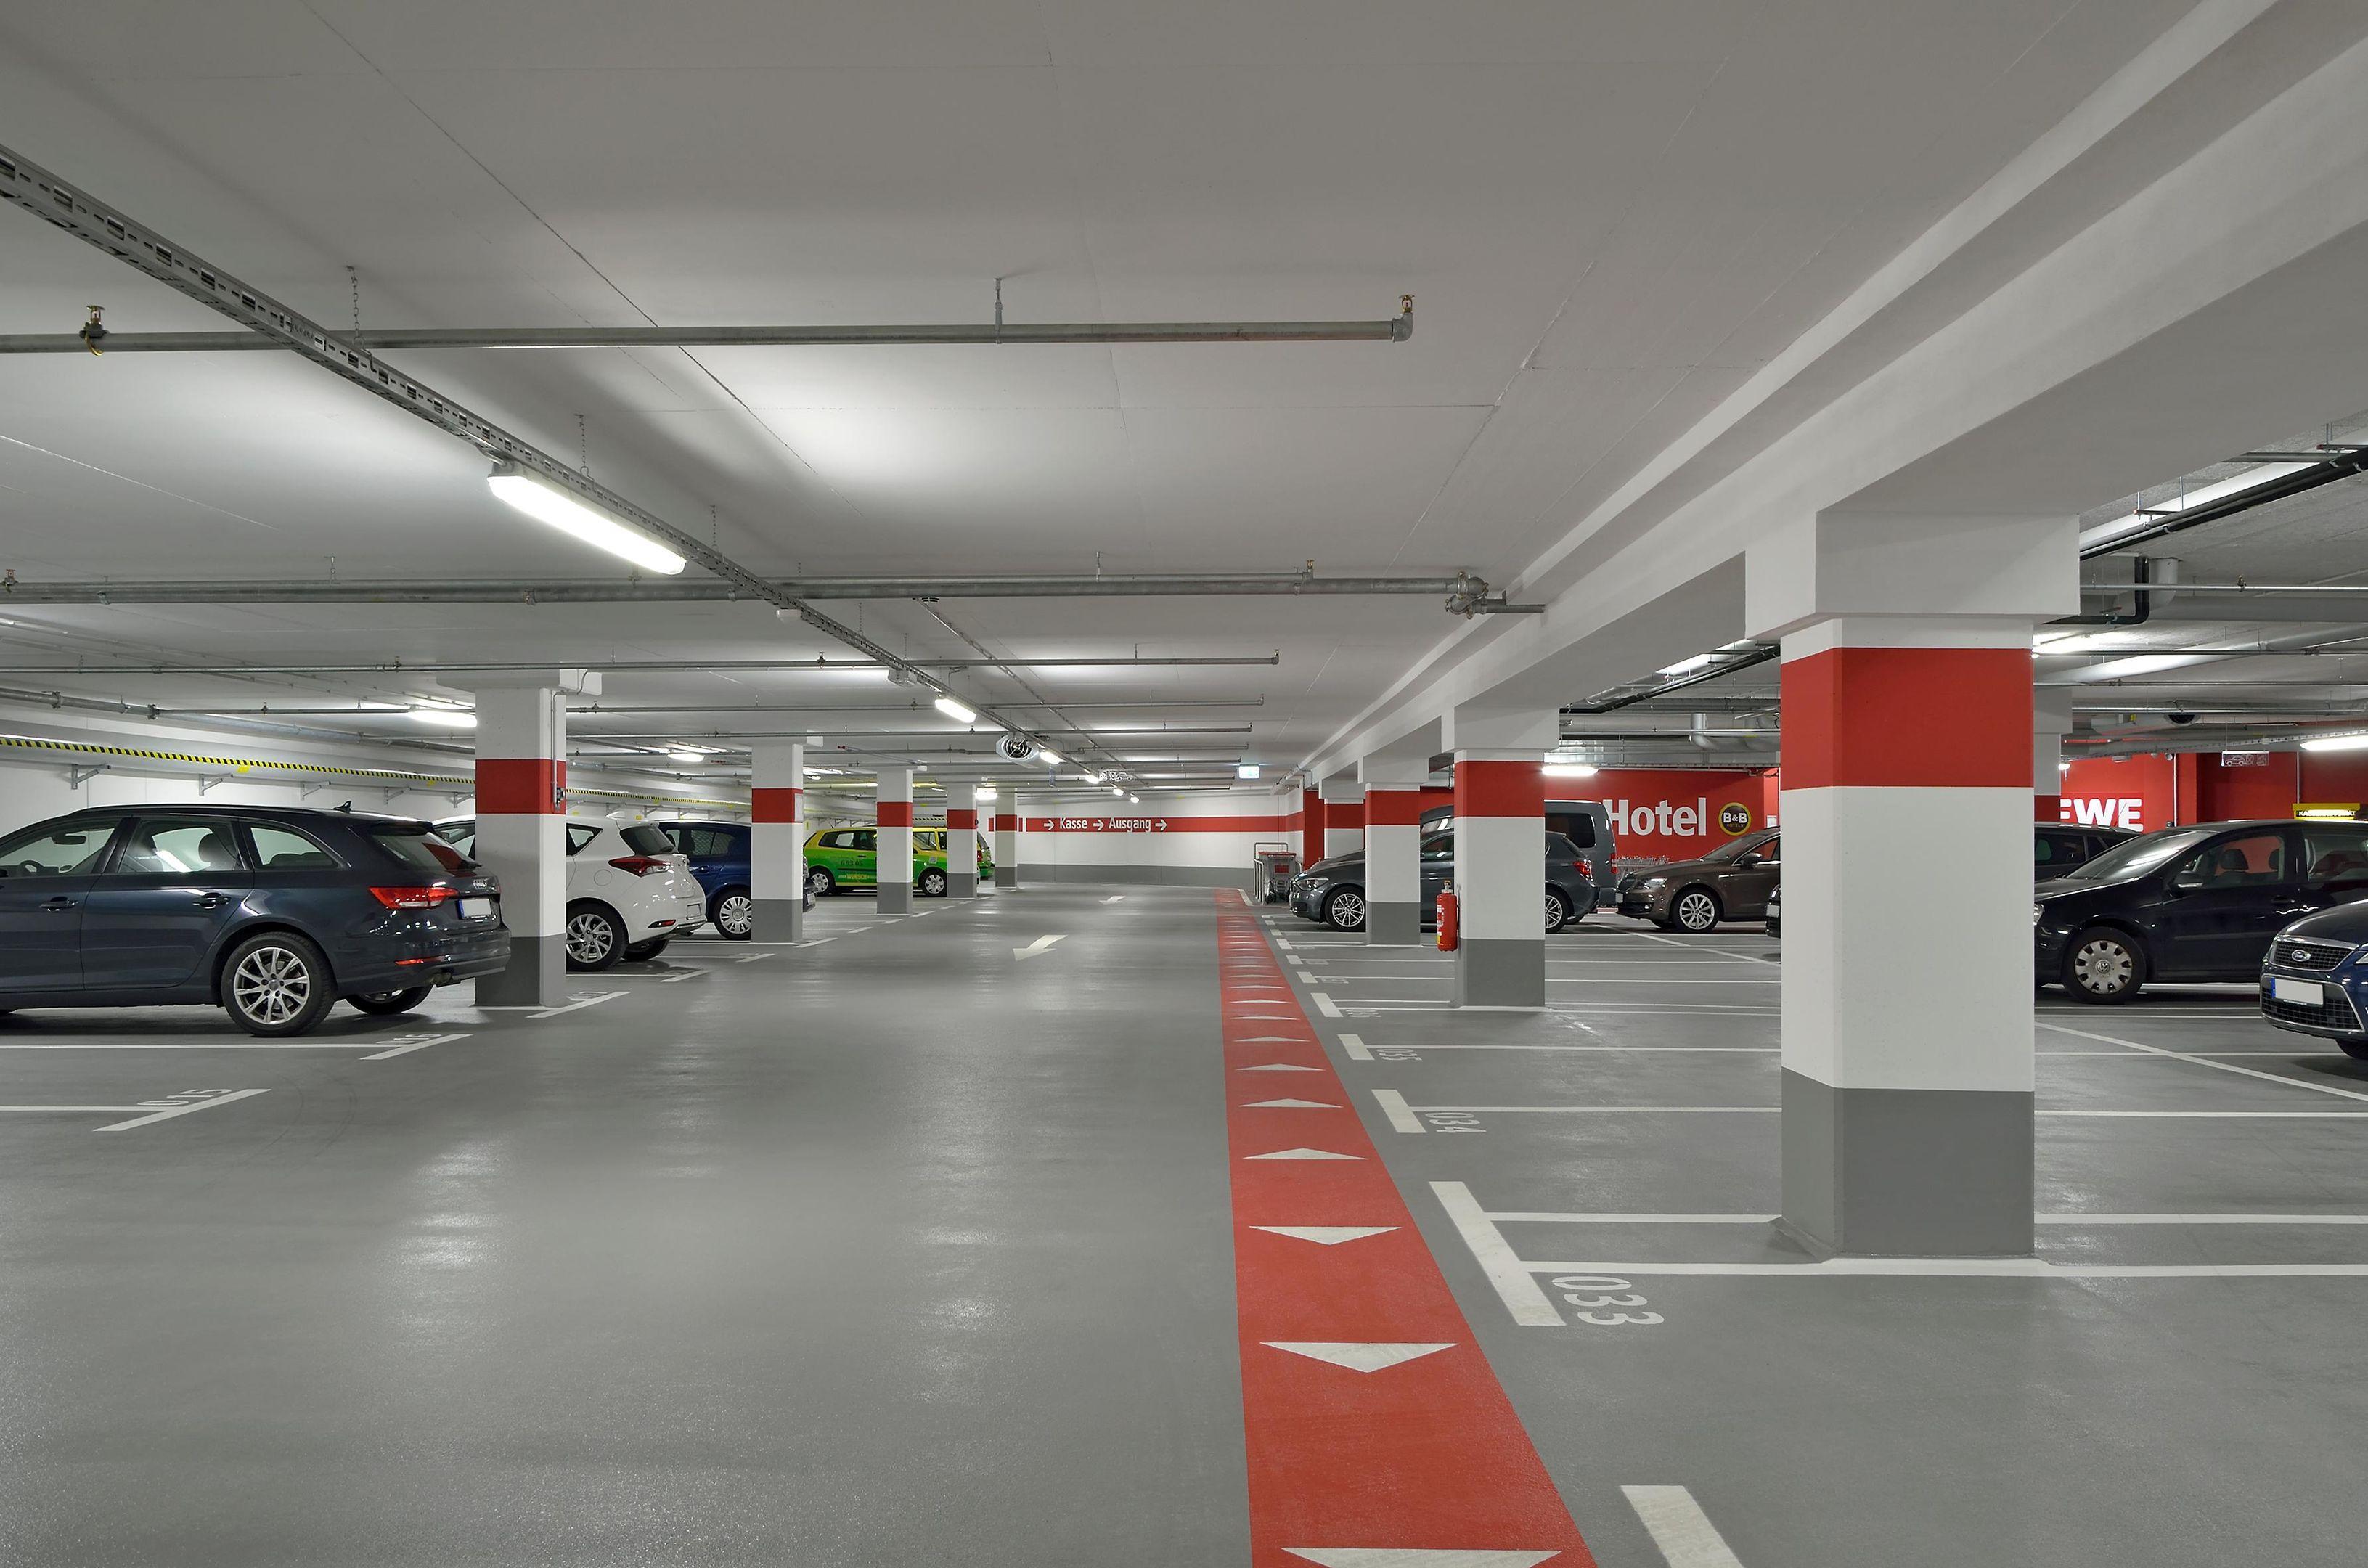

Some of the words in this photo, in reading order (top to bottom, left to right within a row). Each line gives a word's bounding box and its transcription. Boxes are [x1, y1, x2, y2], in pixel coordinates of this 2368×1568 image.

[1059, 817, 1088, 829] Kasse
[1109, 817, 1151, 833] Ausgang
[1603, 797, 1707, 836] Hotel
[1723, 812, 1748, 823] B&B
[376, 1033, 442, 1044] 016
[1376, 1048, 1423, 1061] 035
[136, 1088, 232, 1106] 015
[1425, 1112, 1487, 1133] 034
[1552, 1275, 1665, 1326] 033
